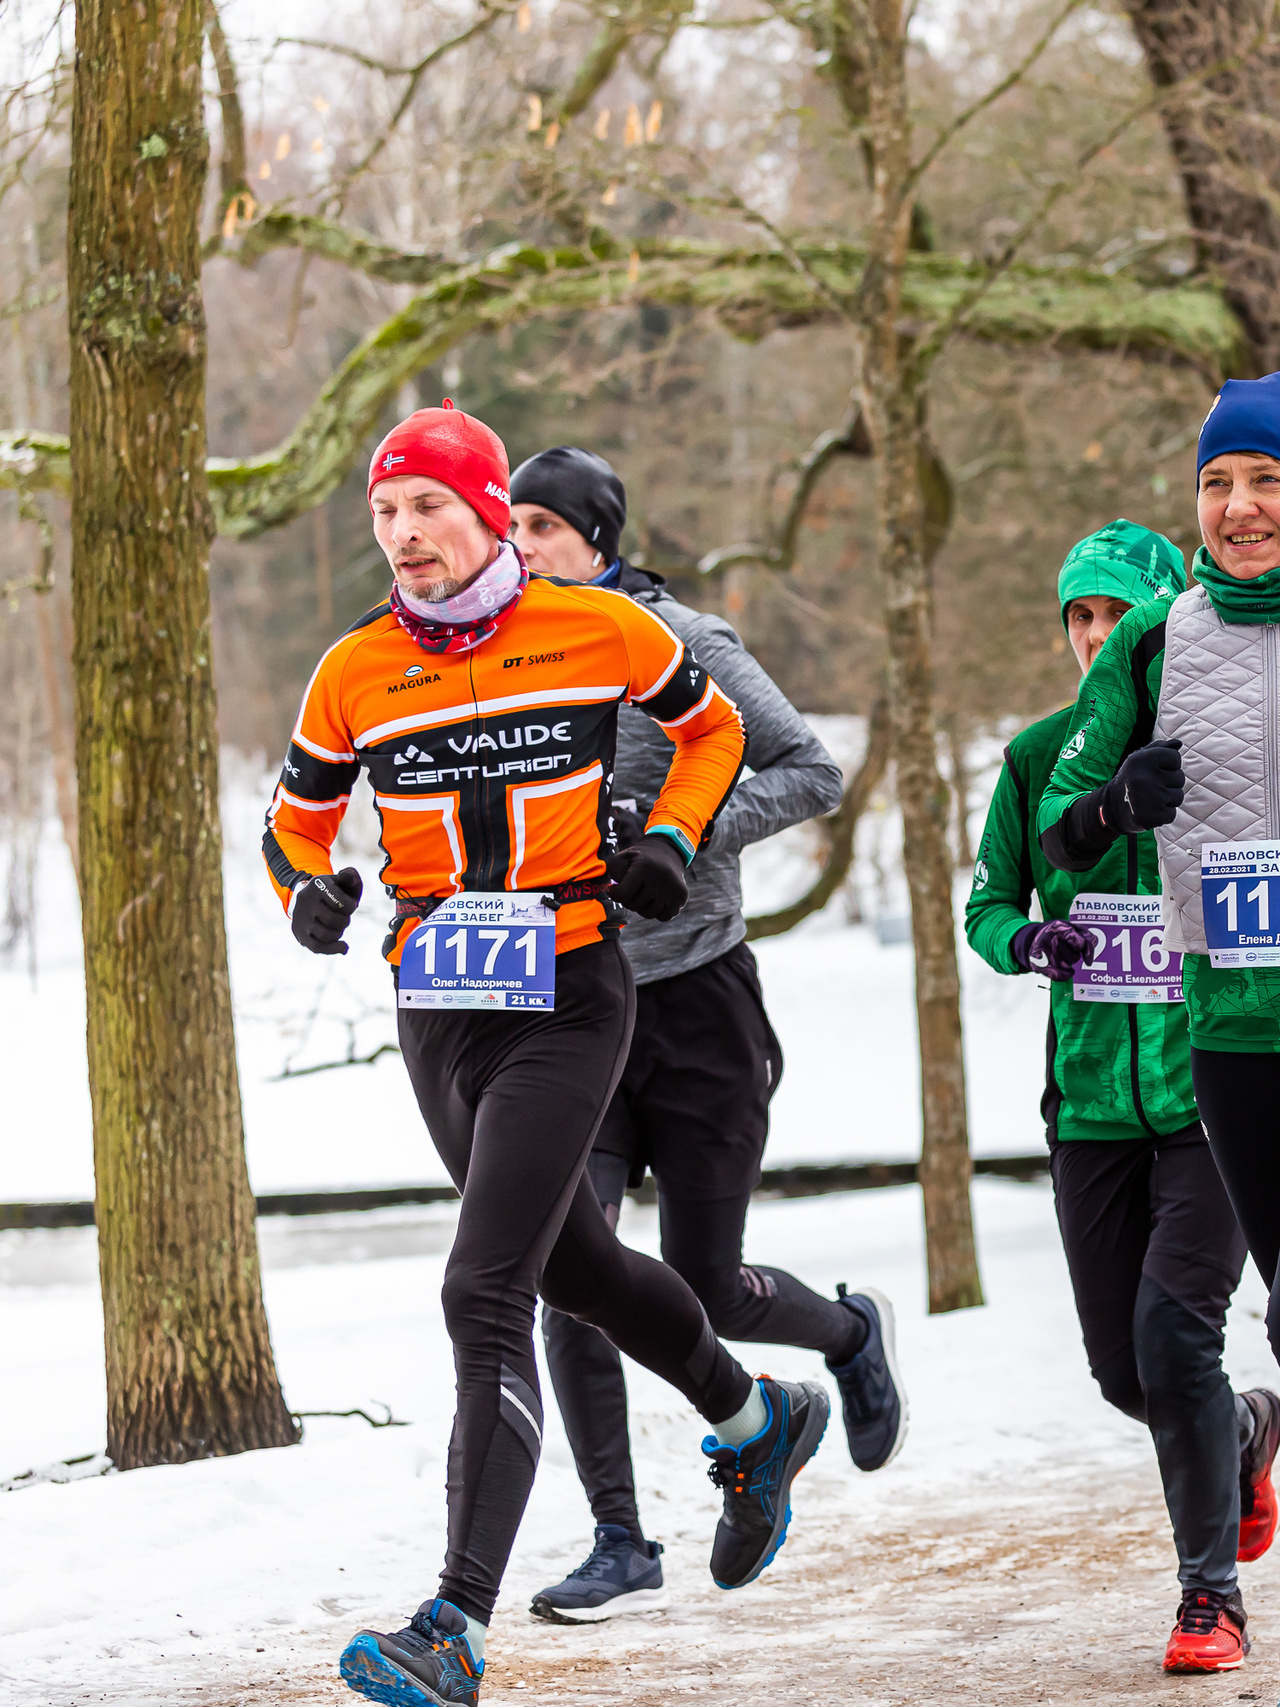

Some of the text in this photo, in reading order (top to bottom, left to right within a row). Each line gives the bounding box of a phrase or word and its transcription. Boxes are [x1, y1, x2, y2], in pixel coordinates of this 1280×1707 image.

[503, 651, 566, 669] DT SWISS
[387, 673, 442, 695] MAGURA
[447, 721, 572, 755] VAUDE
[1208, 866, 1251, 874] 28.02.2021
[1076, 901, 1160, 912] ПАВЛОВСКИЙ
[460, 913, 504, 922] ЗАБЕГ
[1121, 915, 1161, 923] ЗАБЕГ
[1238, 934, 1273, 945] Елена
[415, 927, 537, 977] 1171
[1081, 927, 1185, 973] 216
[431, 977, 523, 990] Олег Надоричев
[1090, 973, 1123, 984] Софья
[511, 995, 526, 1006] 21
